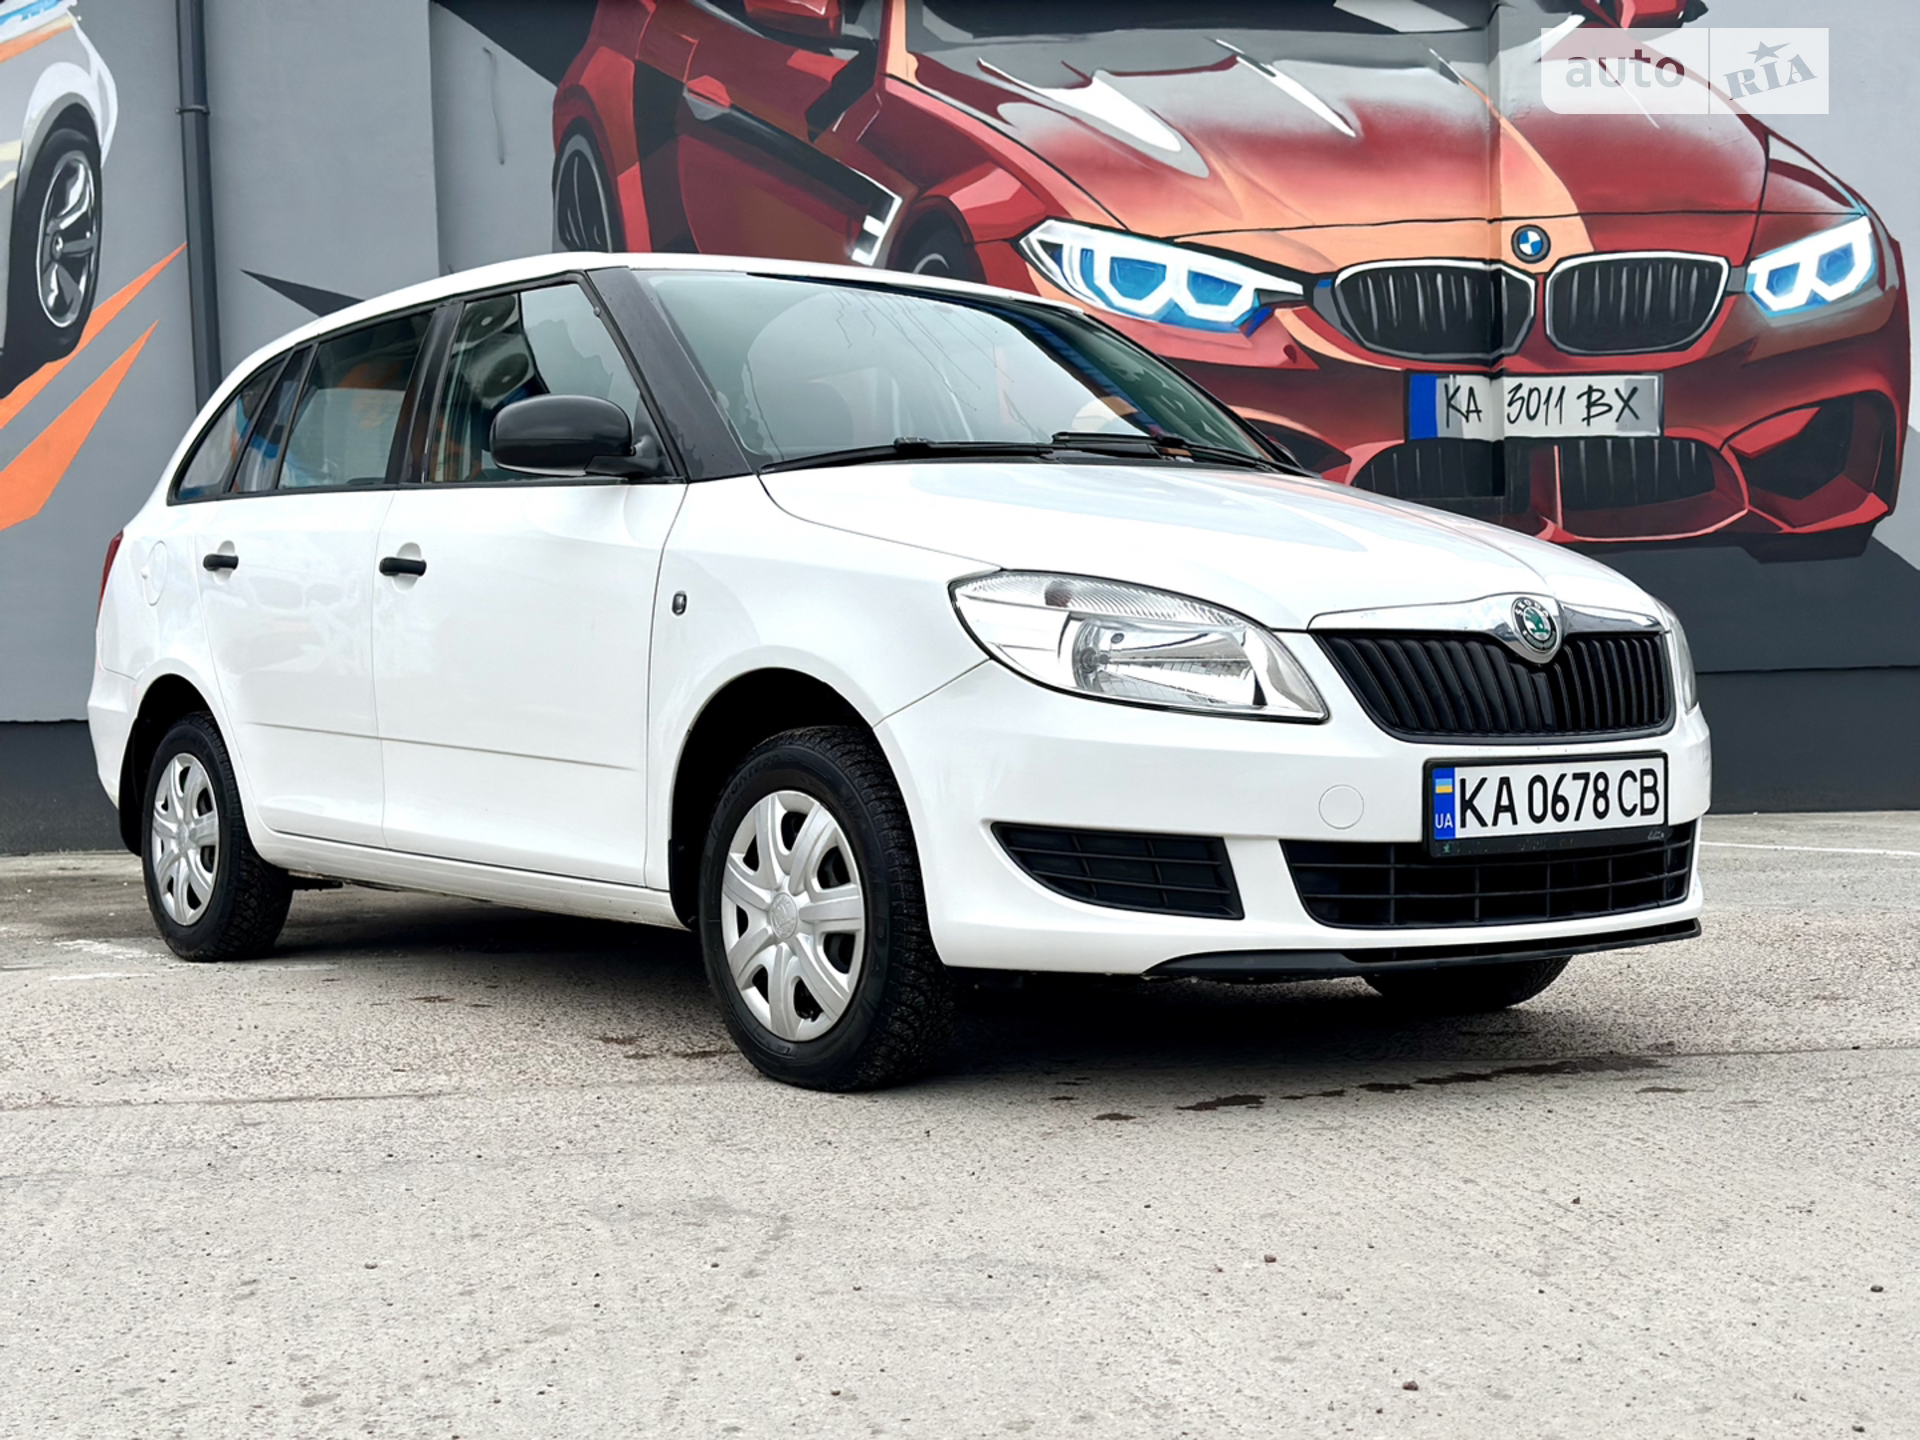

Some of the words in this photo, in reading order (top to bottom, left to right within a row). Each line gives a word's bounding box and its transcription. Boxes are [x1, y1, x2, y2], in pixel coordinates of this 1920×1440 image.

[1444, 383, 1482, 428] KA
[1507, 383, 1566, 426] 3011
[1576, 384, 1639, 427] BX
[1435, 813, 1454, 829] UA
[1459, 776, 1518, 829] KA
[1527, 771, 1610, 824] 0678
[1617, 768, 1660, 817] CB
